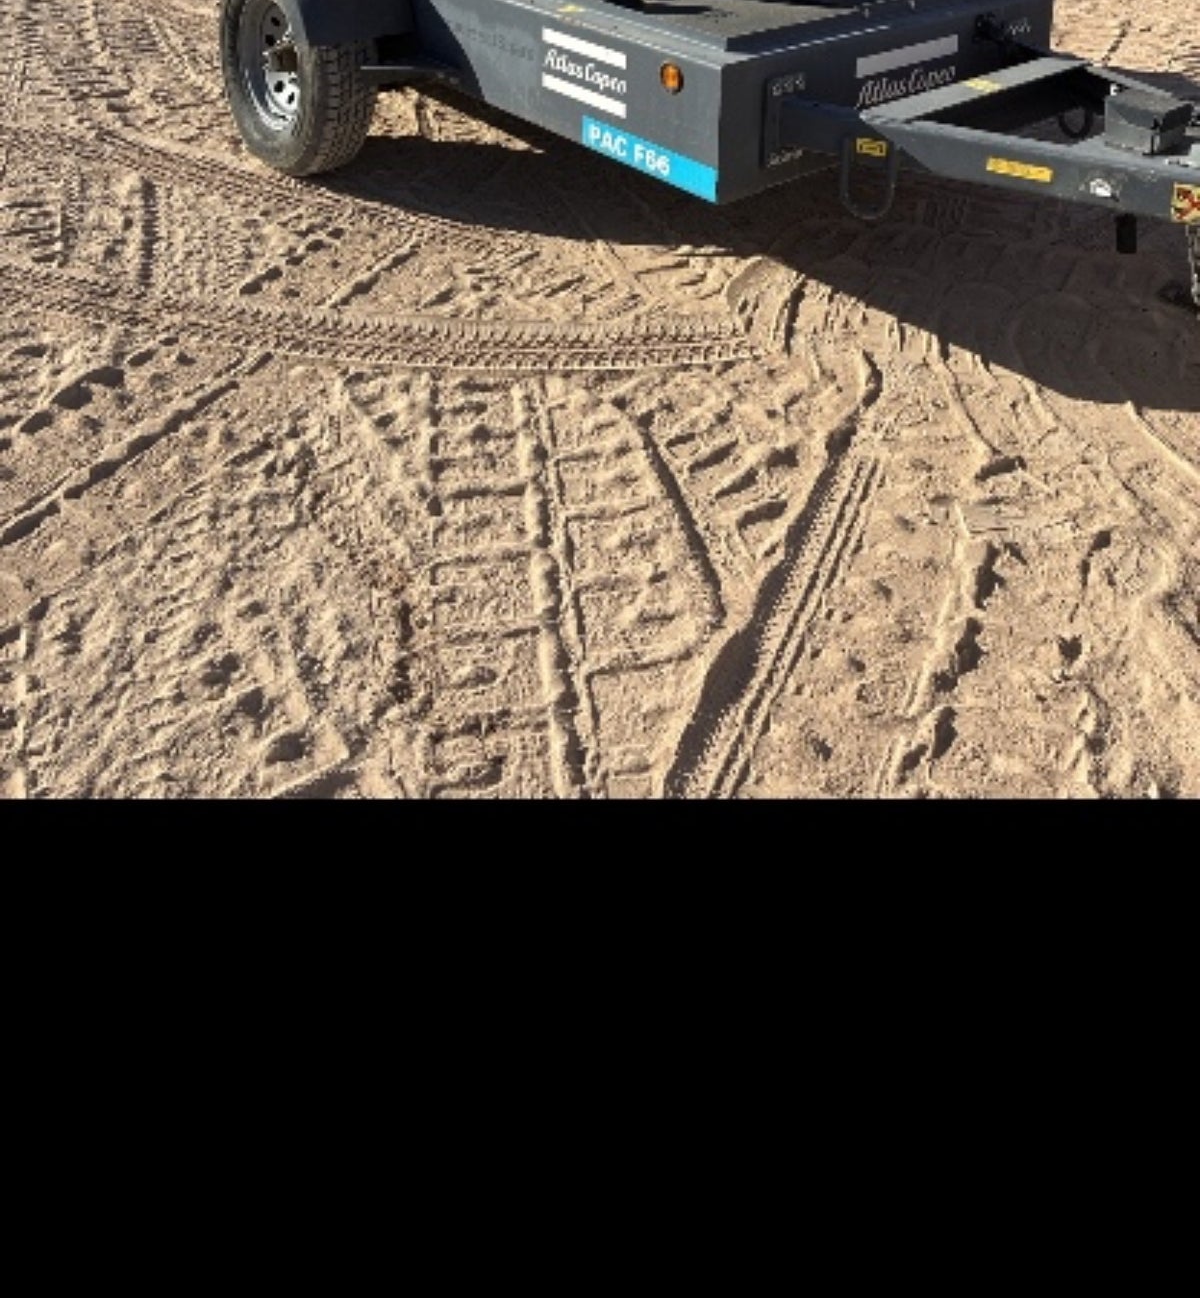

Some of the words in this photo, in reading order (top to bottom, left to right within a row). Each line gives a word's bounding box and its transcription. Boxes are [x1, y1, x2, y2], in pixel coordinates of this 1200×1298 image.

[543, 48, 583, 80] Atlas
[584, 63, 627, 95] Copco
[853, 77, 907, 110] Atlas
[908, 65, 957, 93] Copco
[589, 123, 627, 157] PAC
